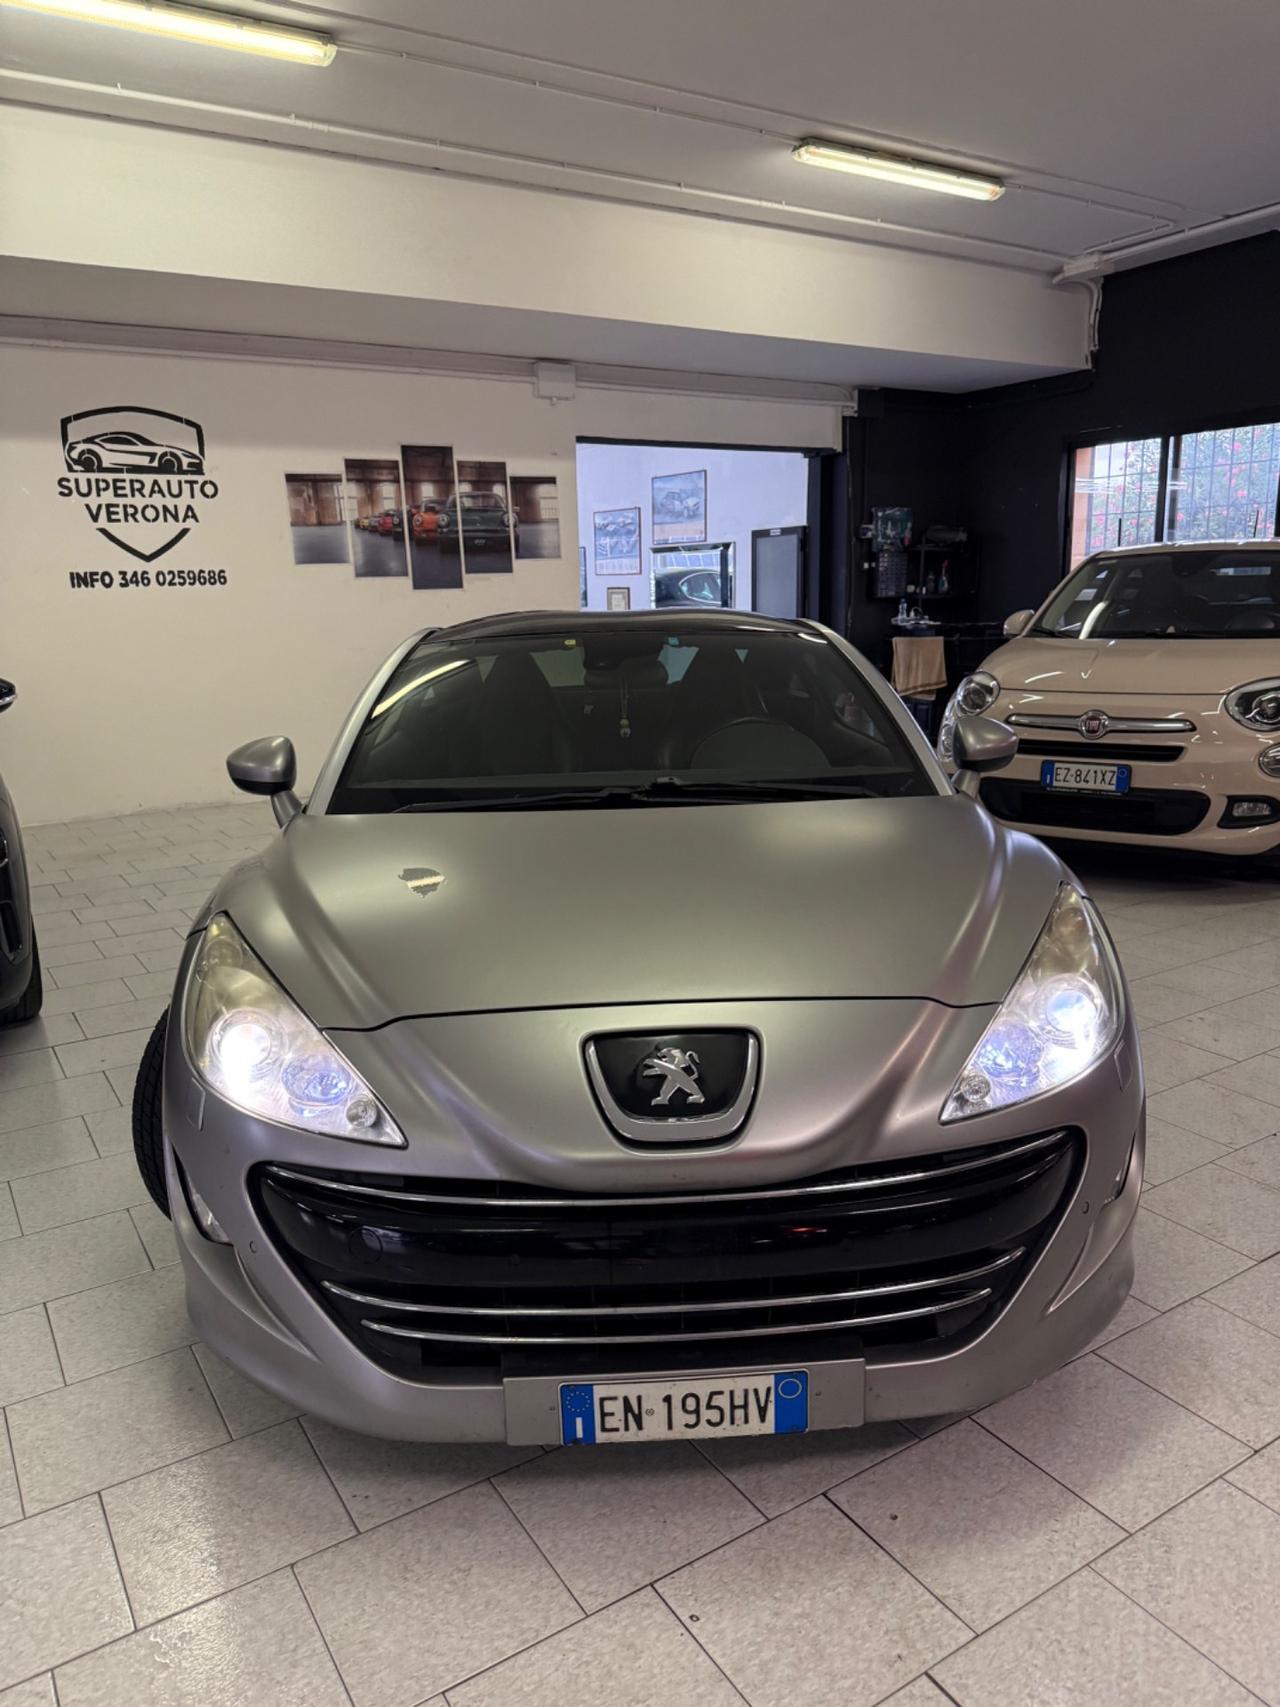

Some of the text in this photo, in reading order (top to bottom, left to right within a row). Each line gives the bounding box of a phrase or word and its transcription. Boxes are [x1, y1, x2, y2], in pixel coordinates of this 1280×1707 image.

[57, 477, 219, 499] SUPERAUTO
[84, 503, 199, 523] VERONA
[69, 569, 227, 588] INFO 346 0259686
